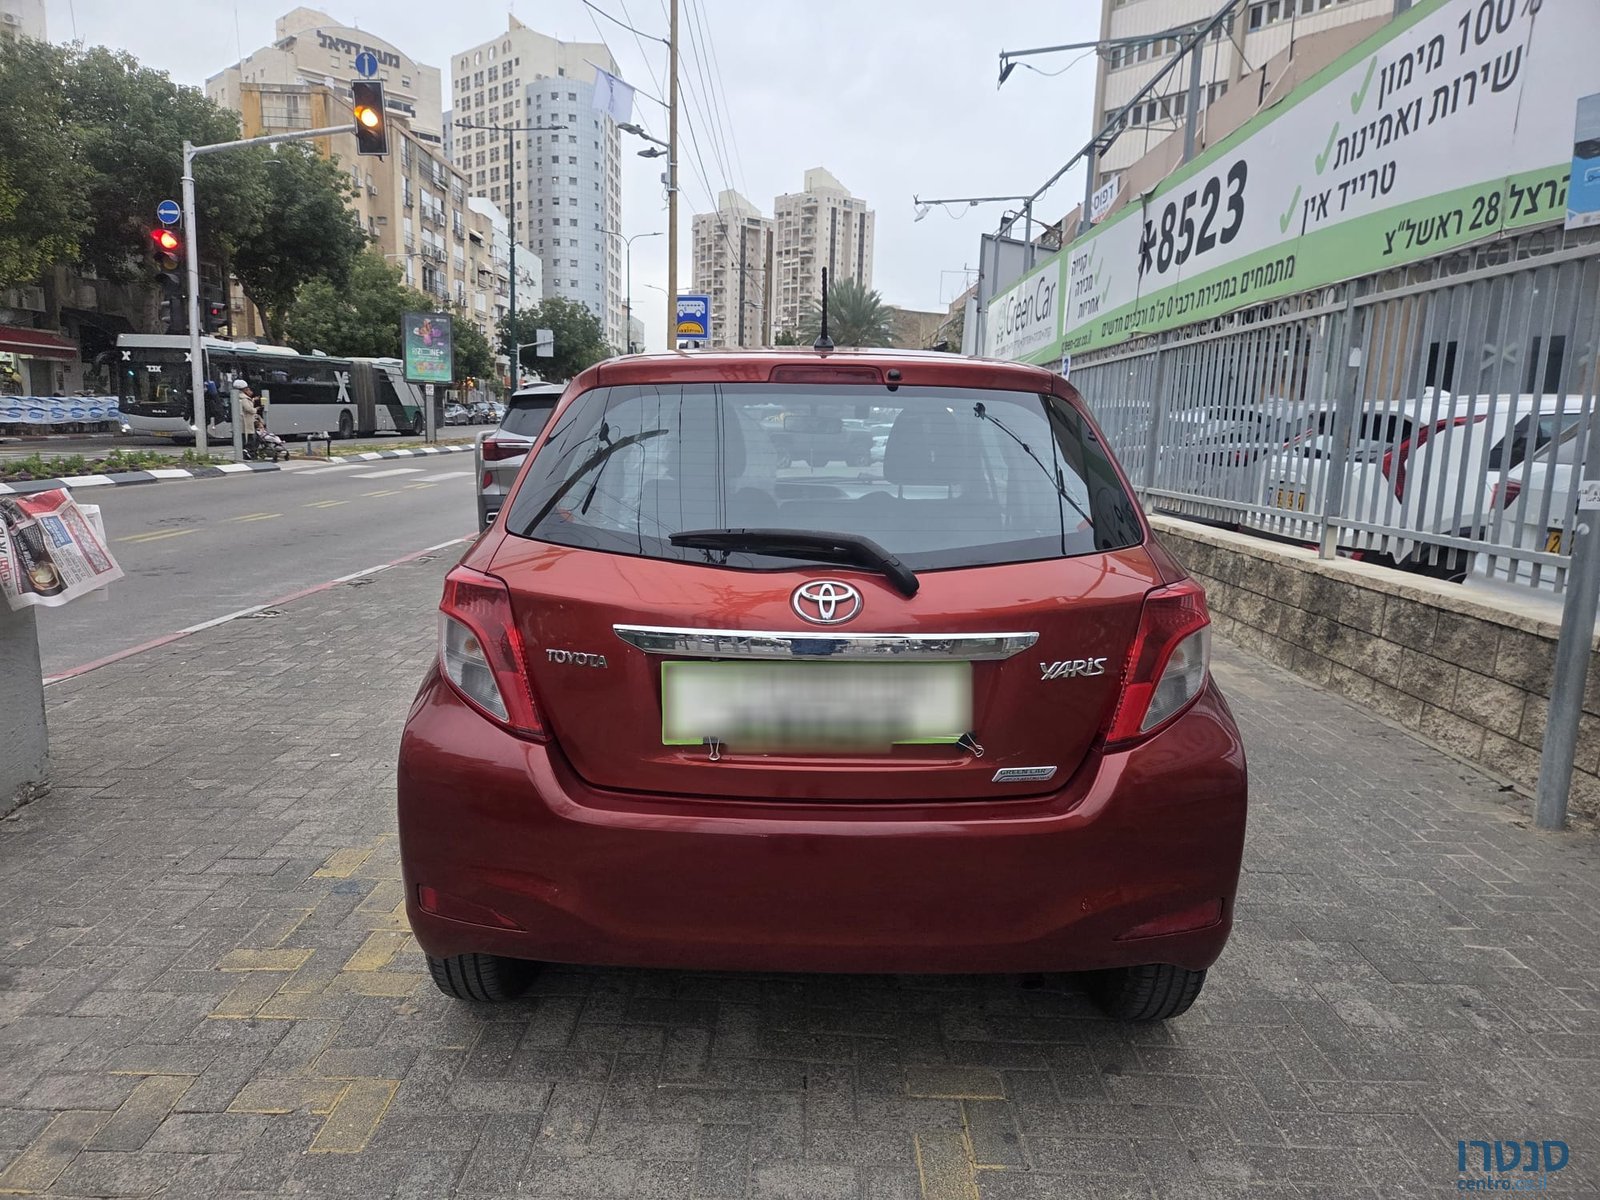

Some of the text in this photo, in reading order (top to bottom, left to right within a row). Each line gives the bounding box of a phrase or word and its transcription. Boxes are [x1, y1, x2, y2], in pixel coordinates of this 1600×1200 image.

[316, 30, 362, 56] דניאל
[1378, 33, 1445, 111] מימון
[1333, 44, 1523, 169] שירות ואמינות
[1301, 160, 1396, 236] טרייד אין
[1469, 190, 1501, 231] 28
[1382, 208, 1463, 256] ראשל"צ
[1196, 276, 1237, 308] במכירת
[1240, 254, 1296, 294] מתמחים
[1006, 276, 1056, 336] Green Car
[1166, 296, 1174, 318] 0
[1175, 292, 1195, 315] רכבי
[1101, 316, 1123, 338] חדשים
[545, 648, 608, 669] TOYOTA
